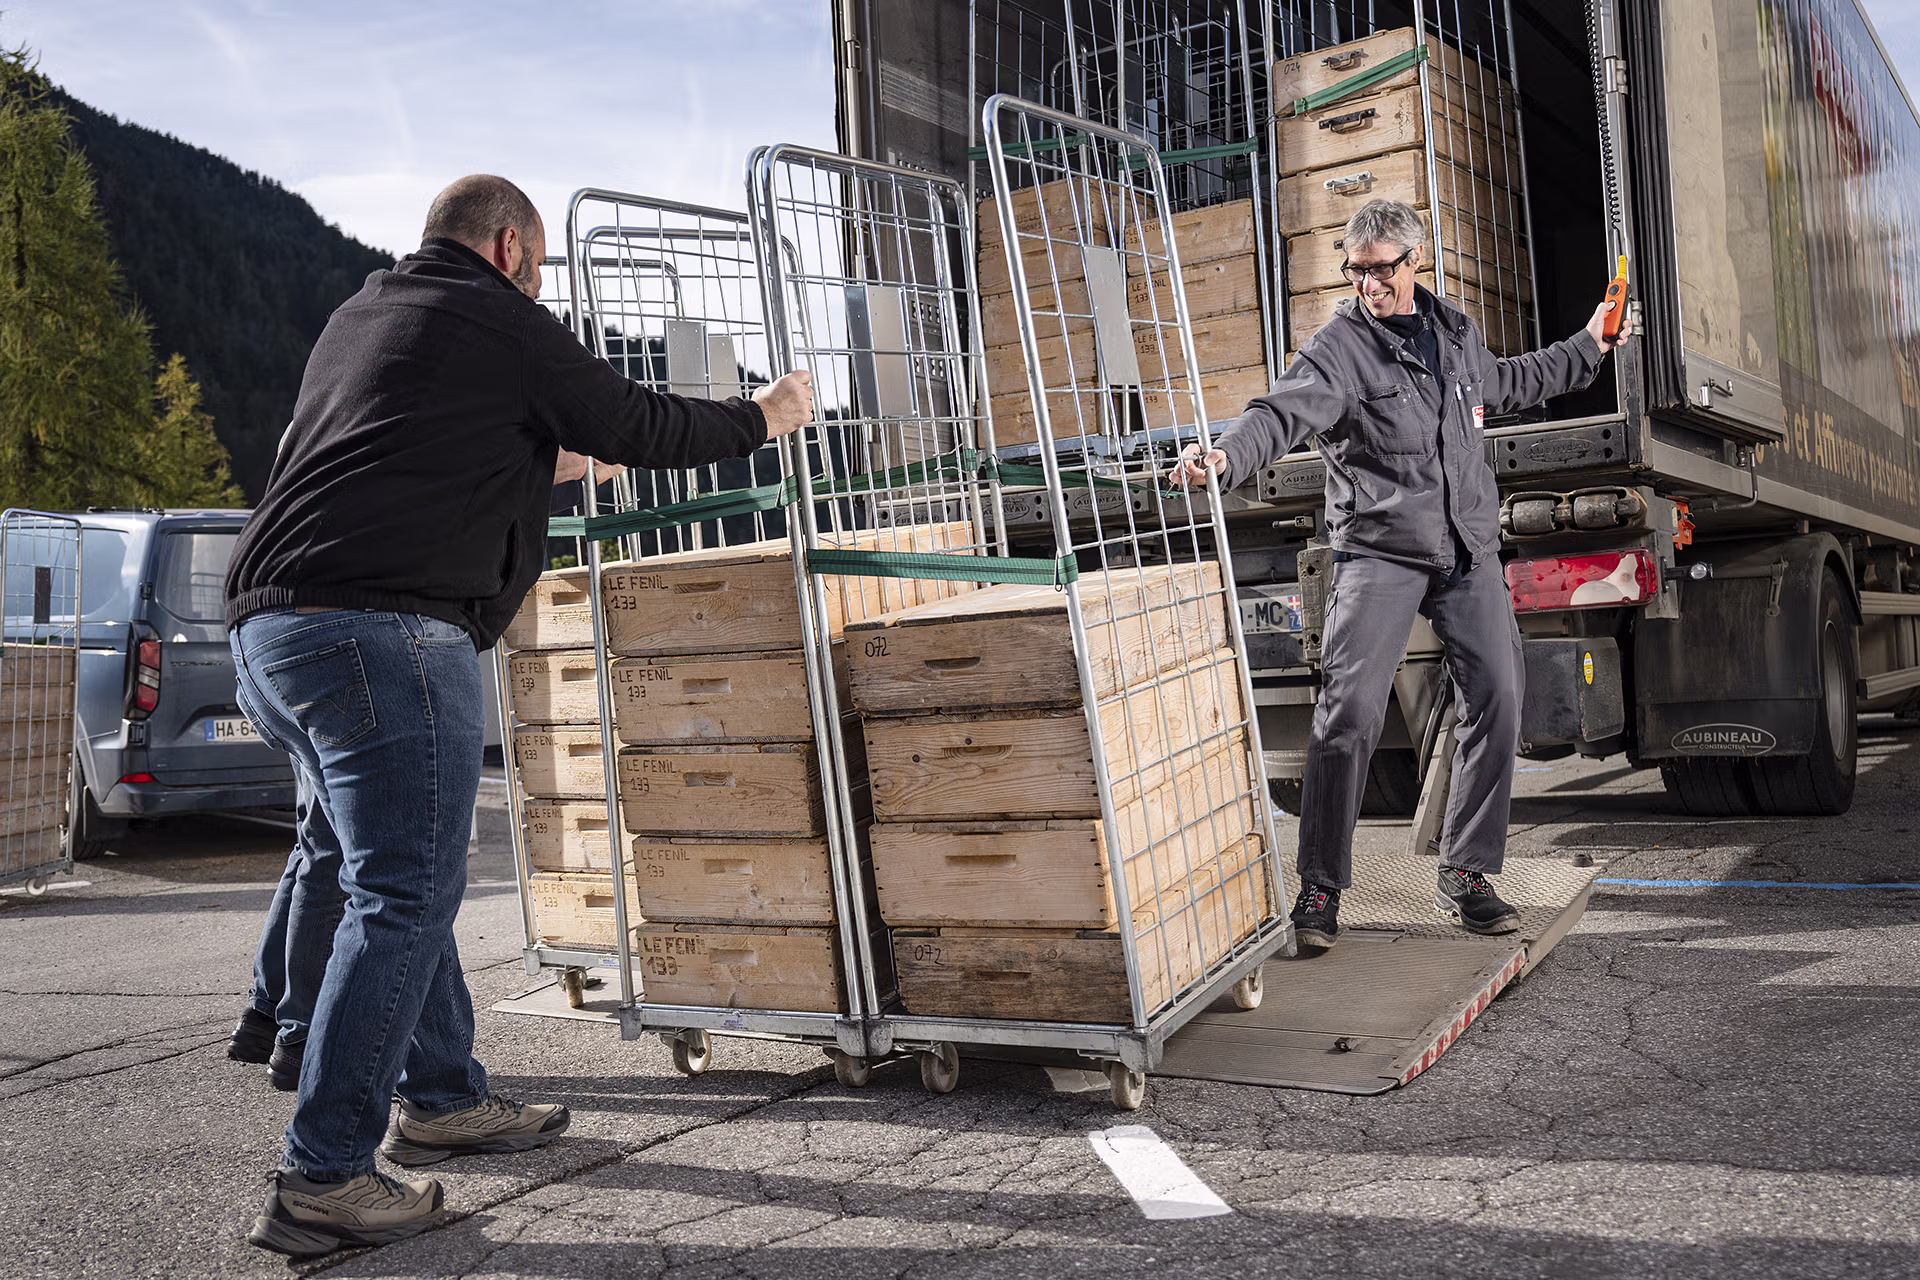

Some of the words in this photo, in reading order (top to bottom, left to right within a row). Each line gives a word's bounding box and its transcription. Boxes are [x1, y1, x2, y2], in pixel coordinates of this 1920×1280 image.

[1283, 61, 1300, 75] 024
[1135, 293, 1148, 304] 133
[1140, 344, 1155, 354] 133
[1145, 395, 1158, 404] 133
[1794, 403, 1811, 463] et
[1814, 409, 1868, 487] Affineurs
[608, 576, 625, 591] LE
[610, 595, 637, 610] 133
[865, 636, 891, 657] 072
[514, 663, 526, 674] LE
[520, 677, 535, 689] 133
[619, 670, 633, 683] LE
[627, 685, 646, 698] 133
[520, 736, 531, 746] LE
[1681, 732, 1761, 743] AUBINEAU
[523, 749, 538, 760] 133
[626, 759, 639, 772] LE
[630, 777, 650, 792] 133
[529, 808, 541, 818] LE
[533, 822, 548, 834] 133
[641, 849, 654, 861] LE
[646, 865, 665, 878] 133
[537, 884, 550, 894] LE
[642, 936, 662, 953] LE
[915, 944, 945, 966] 072
[646, 955, 679, 976] 133
[292, 1200, 329, 1216] SCARPA
